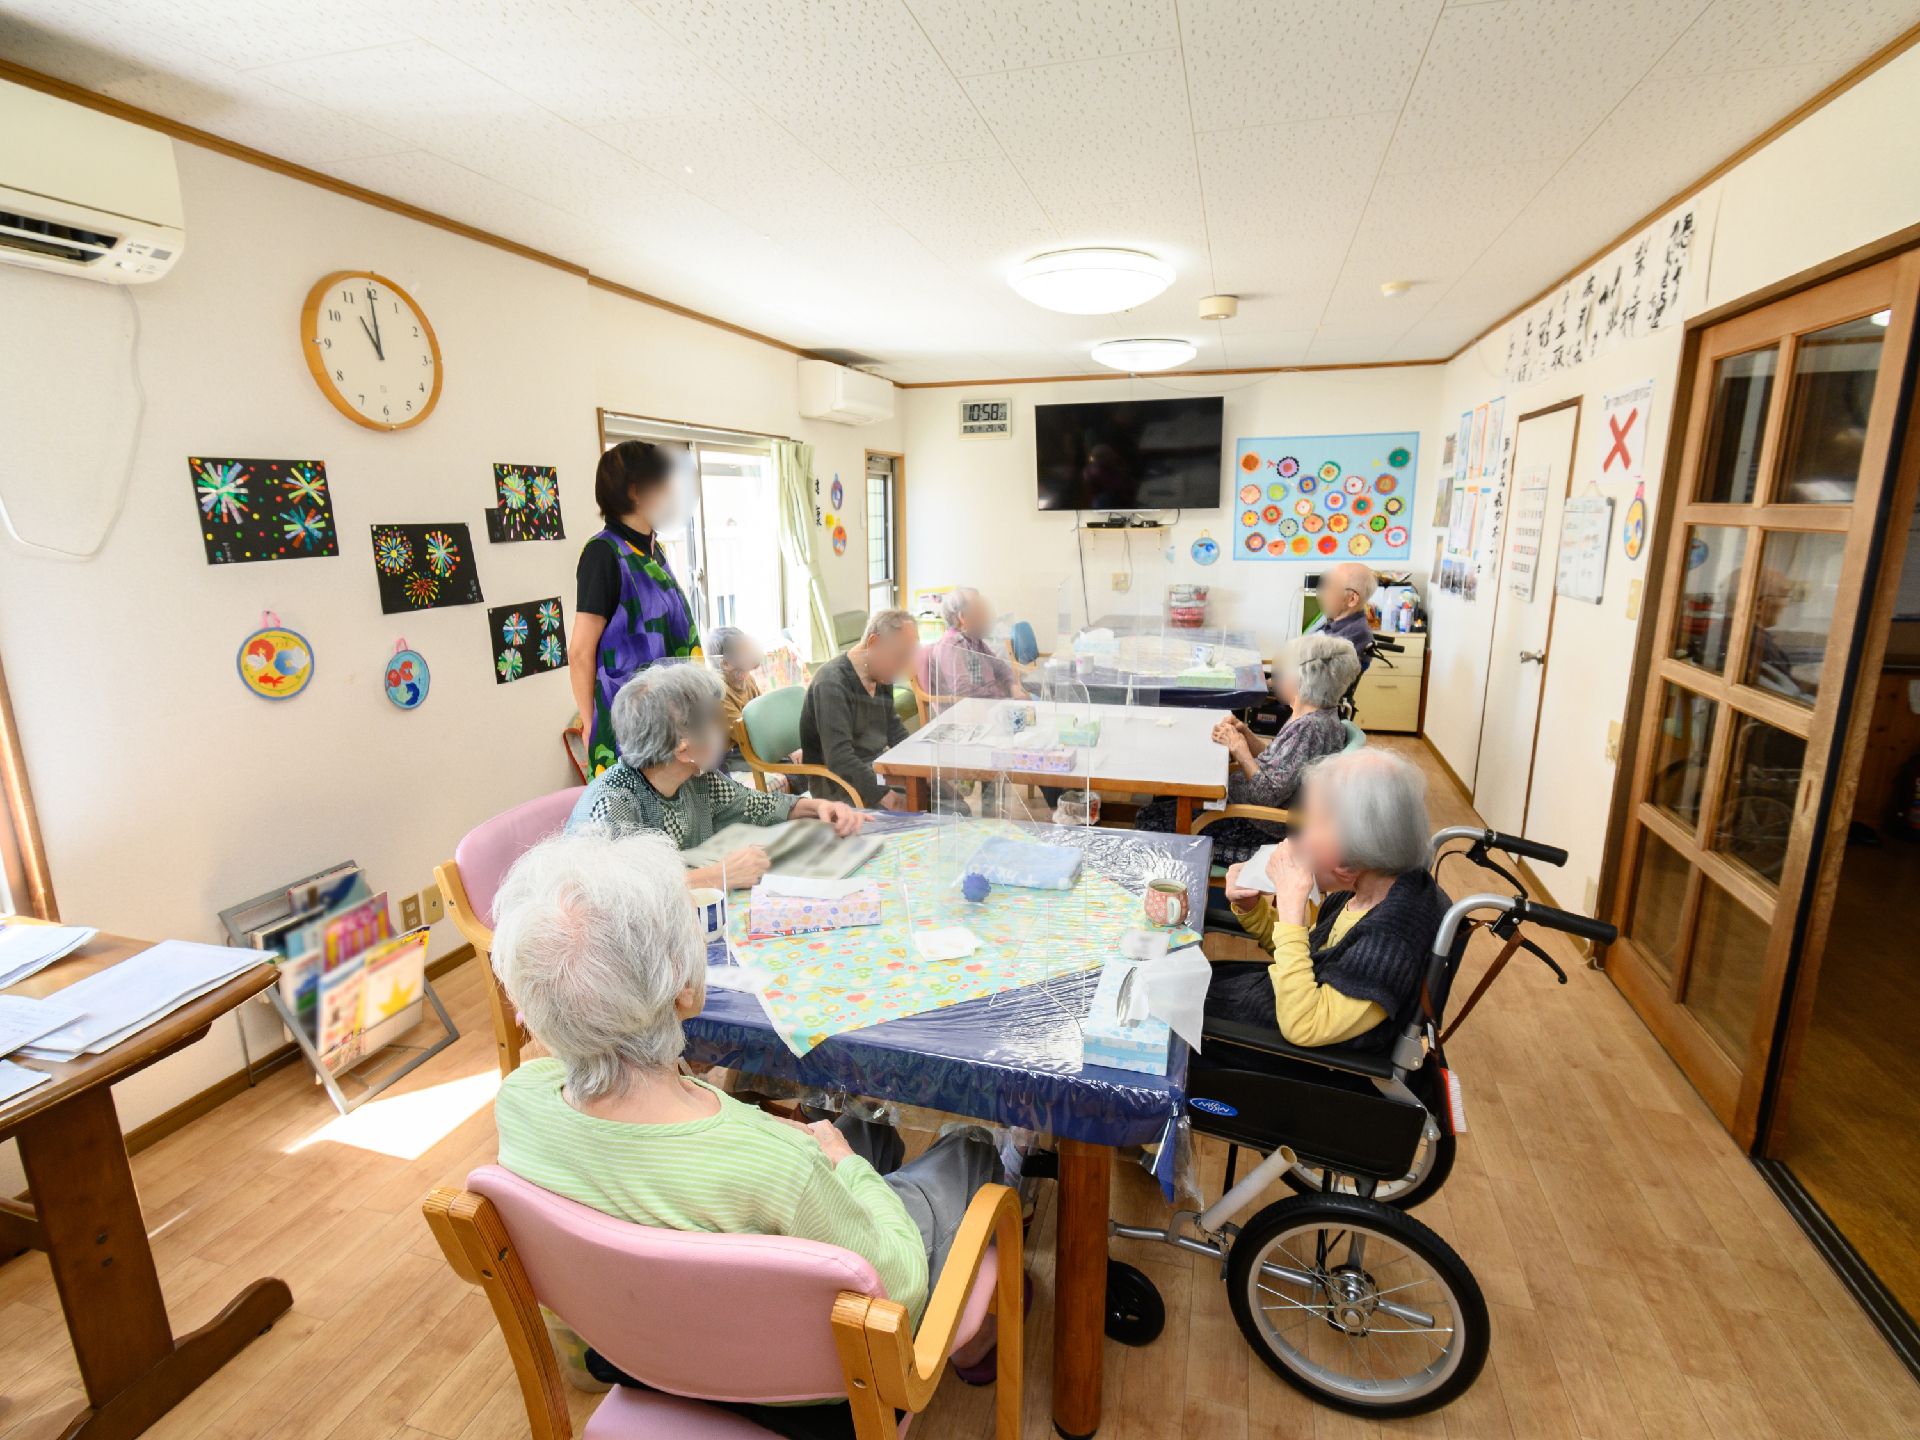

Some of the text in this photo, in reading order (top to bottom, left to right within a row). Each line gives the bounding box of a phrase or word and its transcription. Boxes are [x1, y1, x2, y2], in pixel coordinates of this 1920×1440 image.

[343, 291, 354, 304] 11
[366, 288, 378, 300] 12
[328, 309, 341, 321] 10
[412, 325, 419, 338] 2
[324, 338, 332, 349] 9
[422, 355, 428, 367] 3
[336, 370, 344, 381] 8
[418, 381, 425, 393] 4
[358, 394, 365, 405] 7
[405, 400, 412, 411] 5
[383, 405, 390, 416] 6
[968, 404, 999, 420] 10:58
